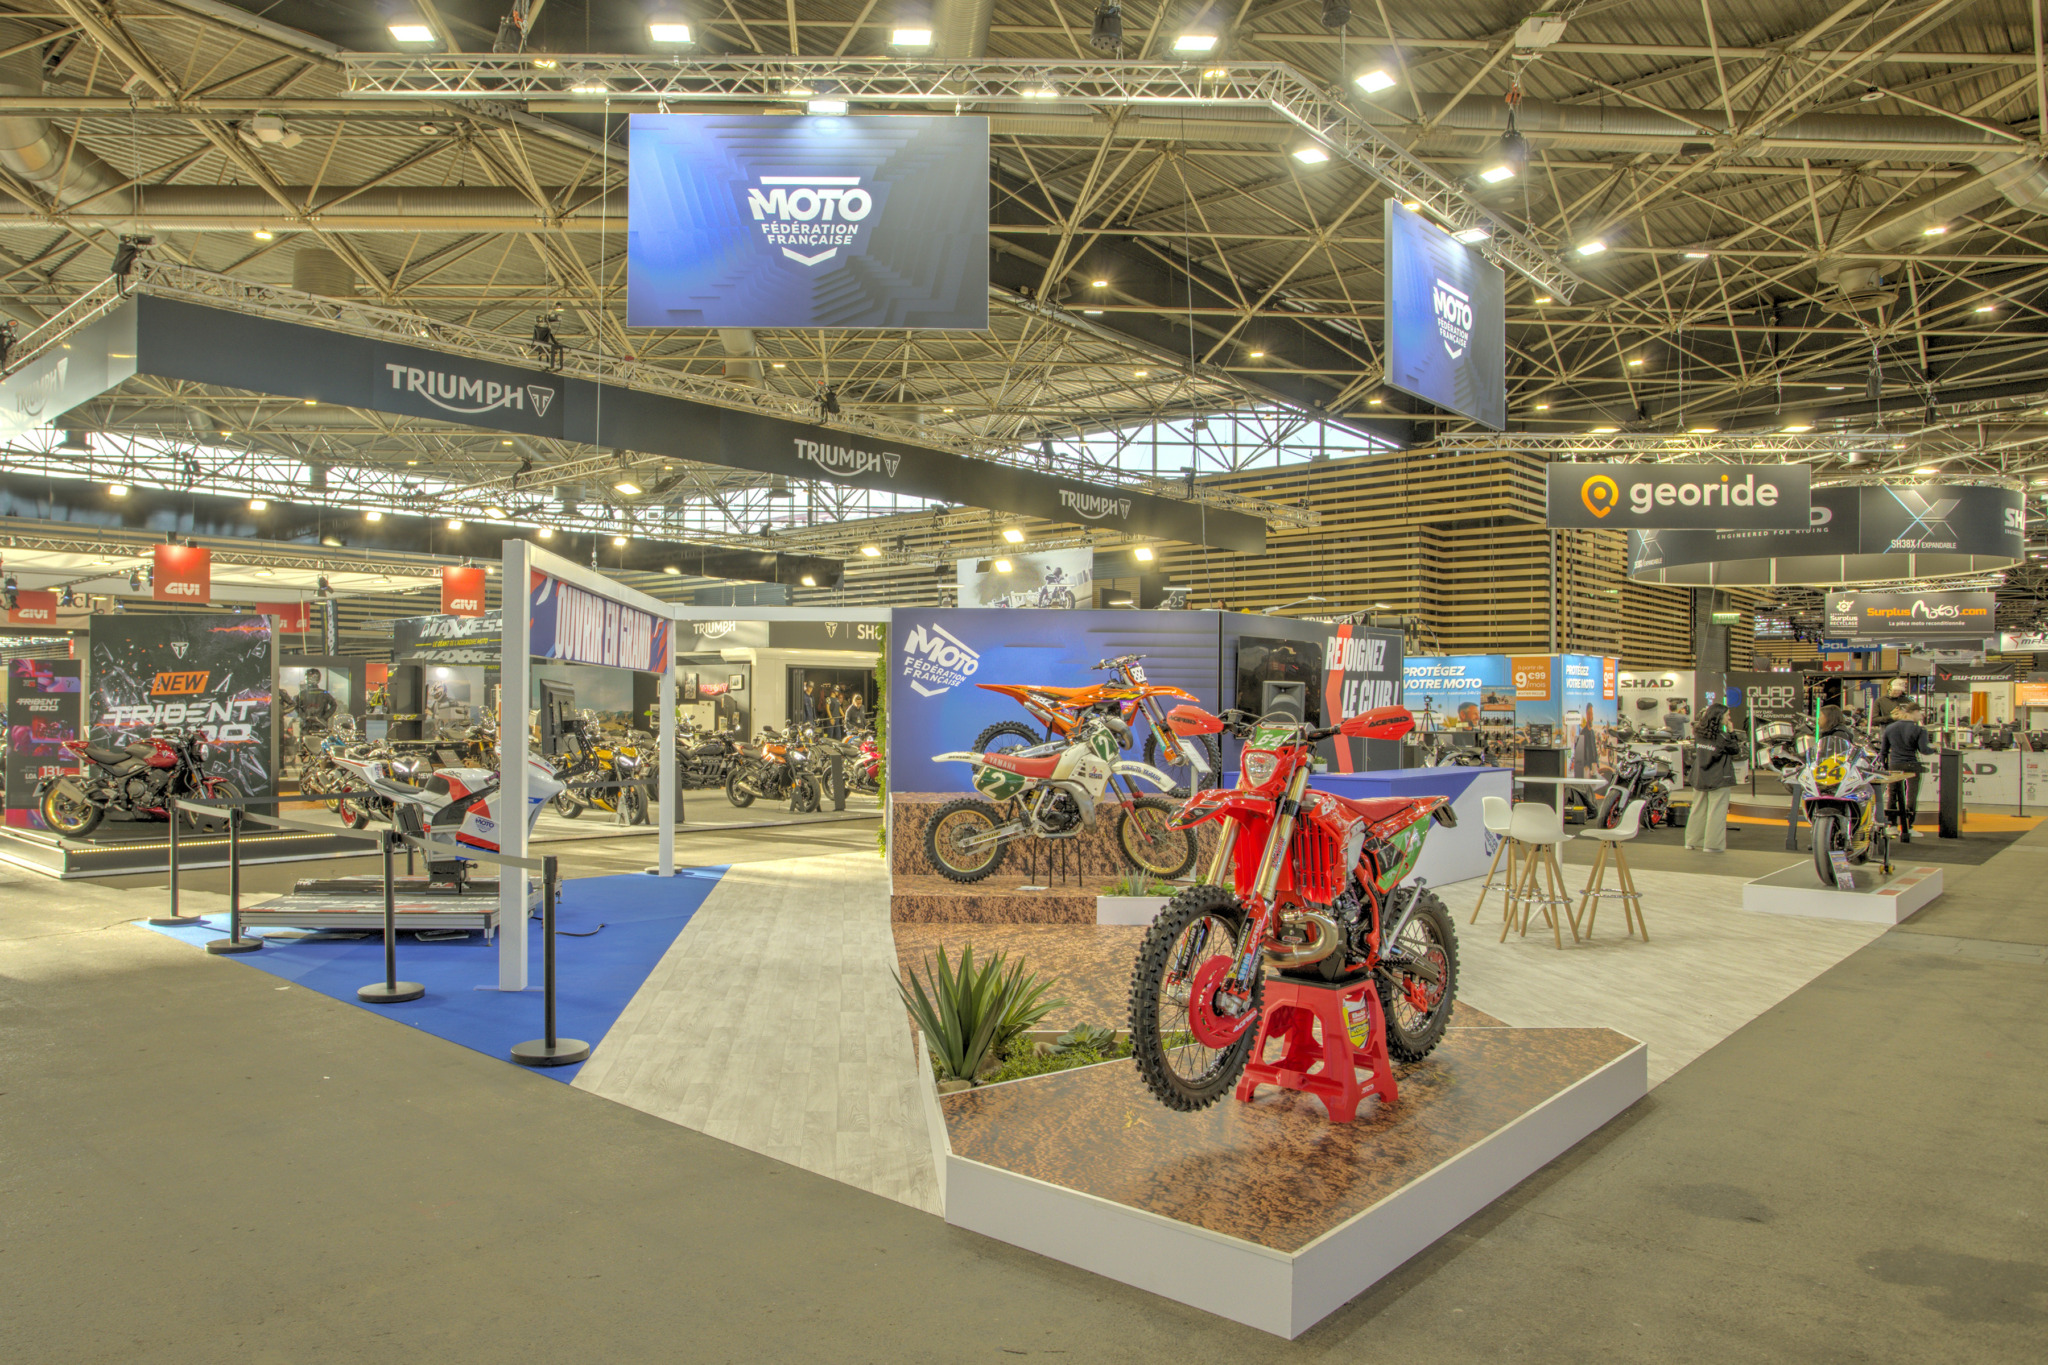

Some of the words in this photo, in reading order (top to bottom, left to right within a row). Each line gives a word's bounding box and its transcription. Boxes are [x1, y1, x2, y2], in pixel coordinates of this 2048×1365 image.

[747, 188, 872, 221] MOTO
[761, 221, 859, 234] FÉDÉRATION
[767, 235, 853, 246] FRANÇAISE
[1433, 286, 1473, 331] MOTO
[1438, 317, 1469, 341] FÉDÉRATION
[1440, 327, 1467, 348] FRANÇAISE
[386, 363, 523, 413] TRIUMPH
[794, 438, 881, 477] TRIUMPH
[1629, 474, 1779, 514] georide
[1059, 489, 1118, 520] TRIUMPH
[1716, 531, 1768, 540] ENGINEERED
[1891, 539, 1916, 549] SH38X
[164, 583, 200, 596] GIVI
[450, 599, 477, 610] GIVI
[1171, 596, 1184, 607] 25
[18, 608, 48, 619] GIVI
[554, 583, 605, 664] OUVRIR
[604, 600, 620, 666] EN
[619, 605, 652, 670] GRAND
[693, 621, 736, 639] TRIUMPH
[904, 624, 979, 676] MOTO
[1325, 636, 1387, 672] REJOIGNEZ
[904, 656, 967, 682] FÉDÉRATION
[1403, 664, 1466, 678] PROTÉGEZ
[1565, 663, 1589, 676] PROTÉGEZ
[156, 674, 205, 692] NEW
[903, 667, 961, 687] FRANÇAISE
[1403, 679, 1443, 690] VOTRE
[1443, 678, 1482, 690] MOTO
[1515, 672, 1527, 688] 9
[1566, 678, 1580, 689] VOTRE
[1581, 679, 1595, 689] MOTO
[1620, 679, 1674, 688] SHAD
[1747, 686, 1795, 697] QUAD
[1341, 680, 1359, 719] LE
[1747, 697, 1796, 708] LOCK
[103, 700, 258, 727] TRIDENT
[1168, 715, 1197, 725] ACERBIS
[1368, 716, 1410, 728] ACERBIS
[1256, 734, 1283, 747] 64
[990, 756, 1016, 771] YAMAHA
[983, 772, 1006, 798] 2
